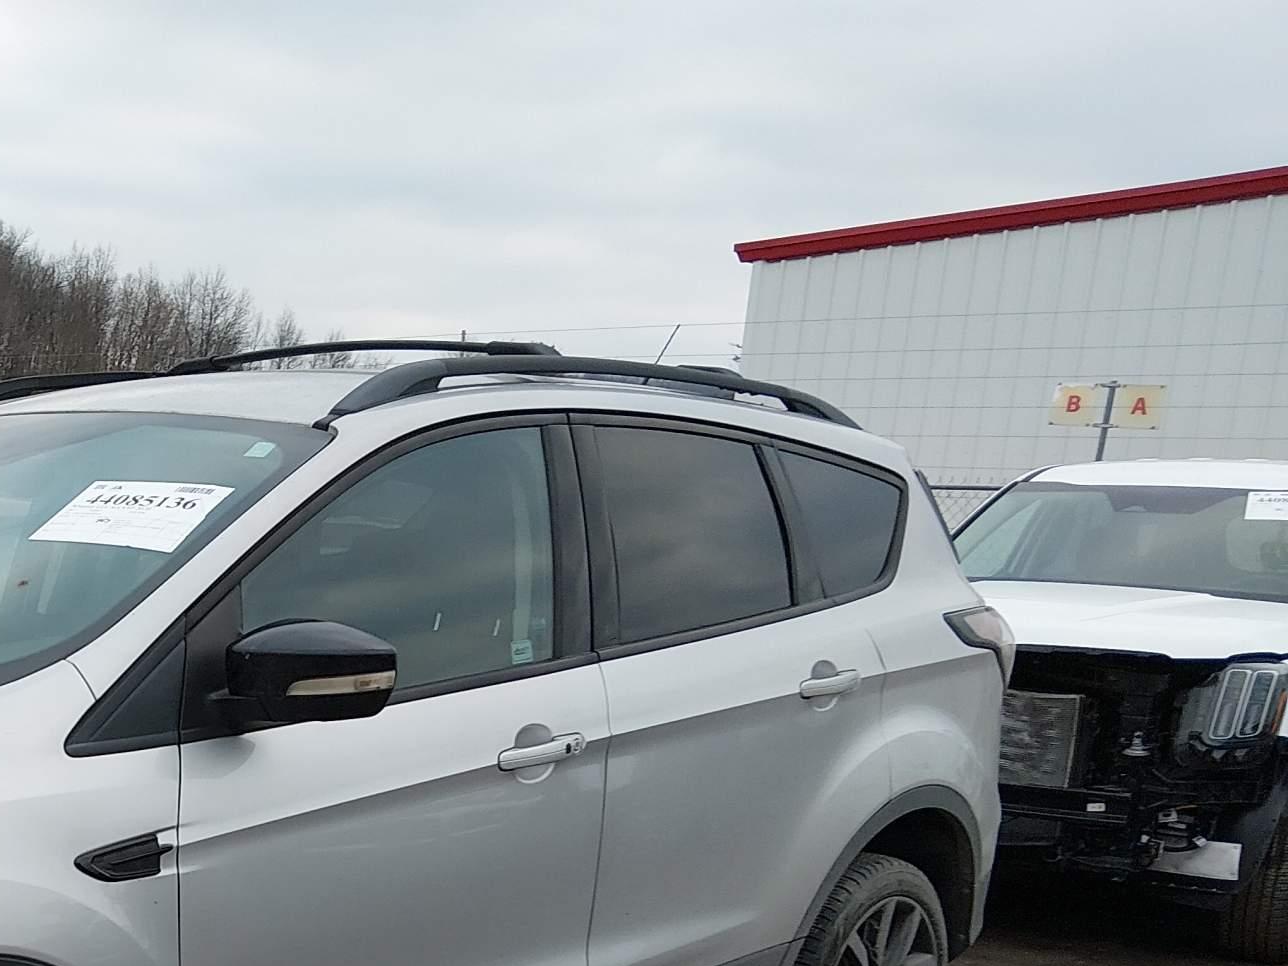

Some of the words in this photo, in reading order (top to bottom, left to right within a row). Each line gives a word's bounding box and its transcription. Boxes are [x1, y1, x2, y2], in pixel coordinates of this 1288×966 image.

[1066, 395, 1081, 412] B
[1130, 397, 1146, 415] A
[85, 493, 200, 510] 44085136
